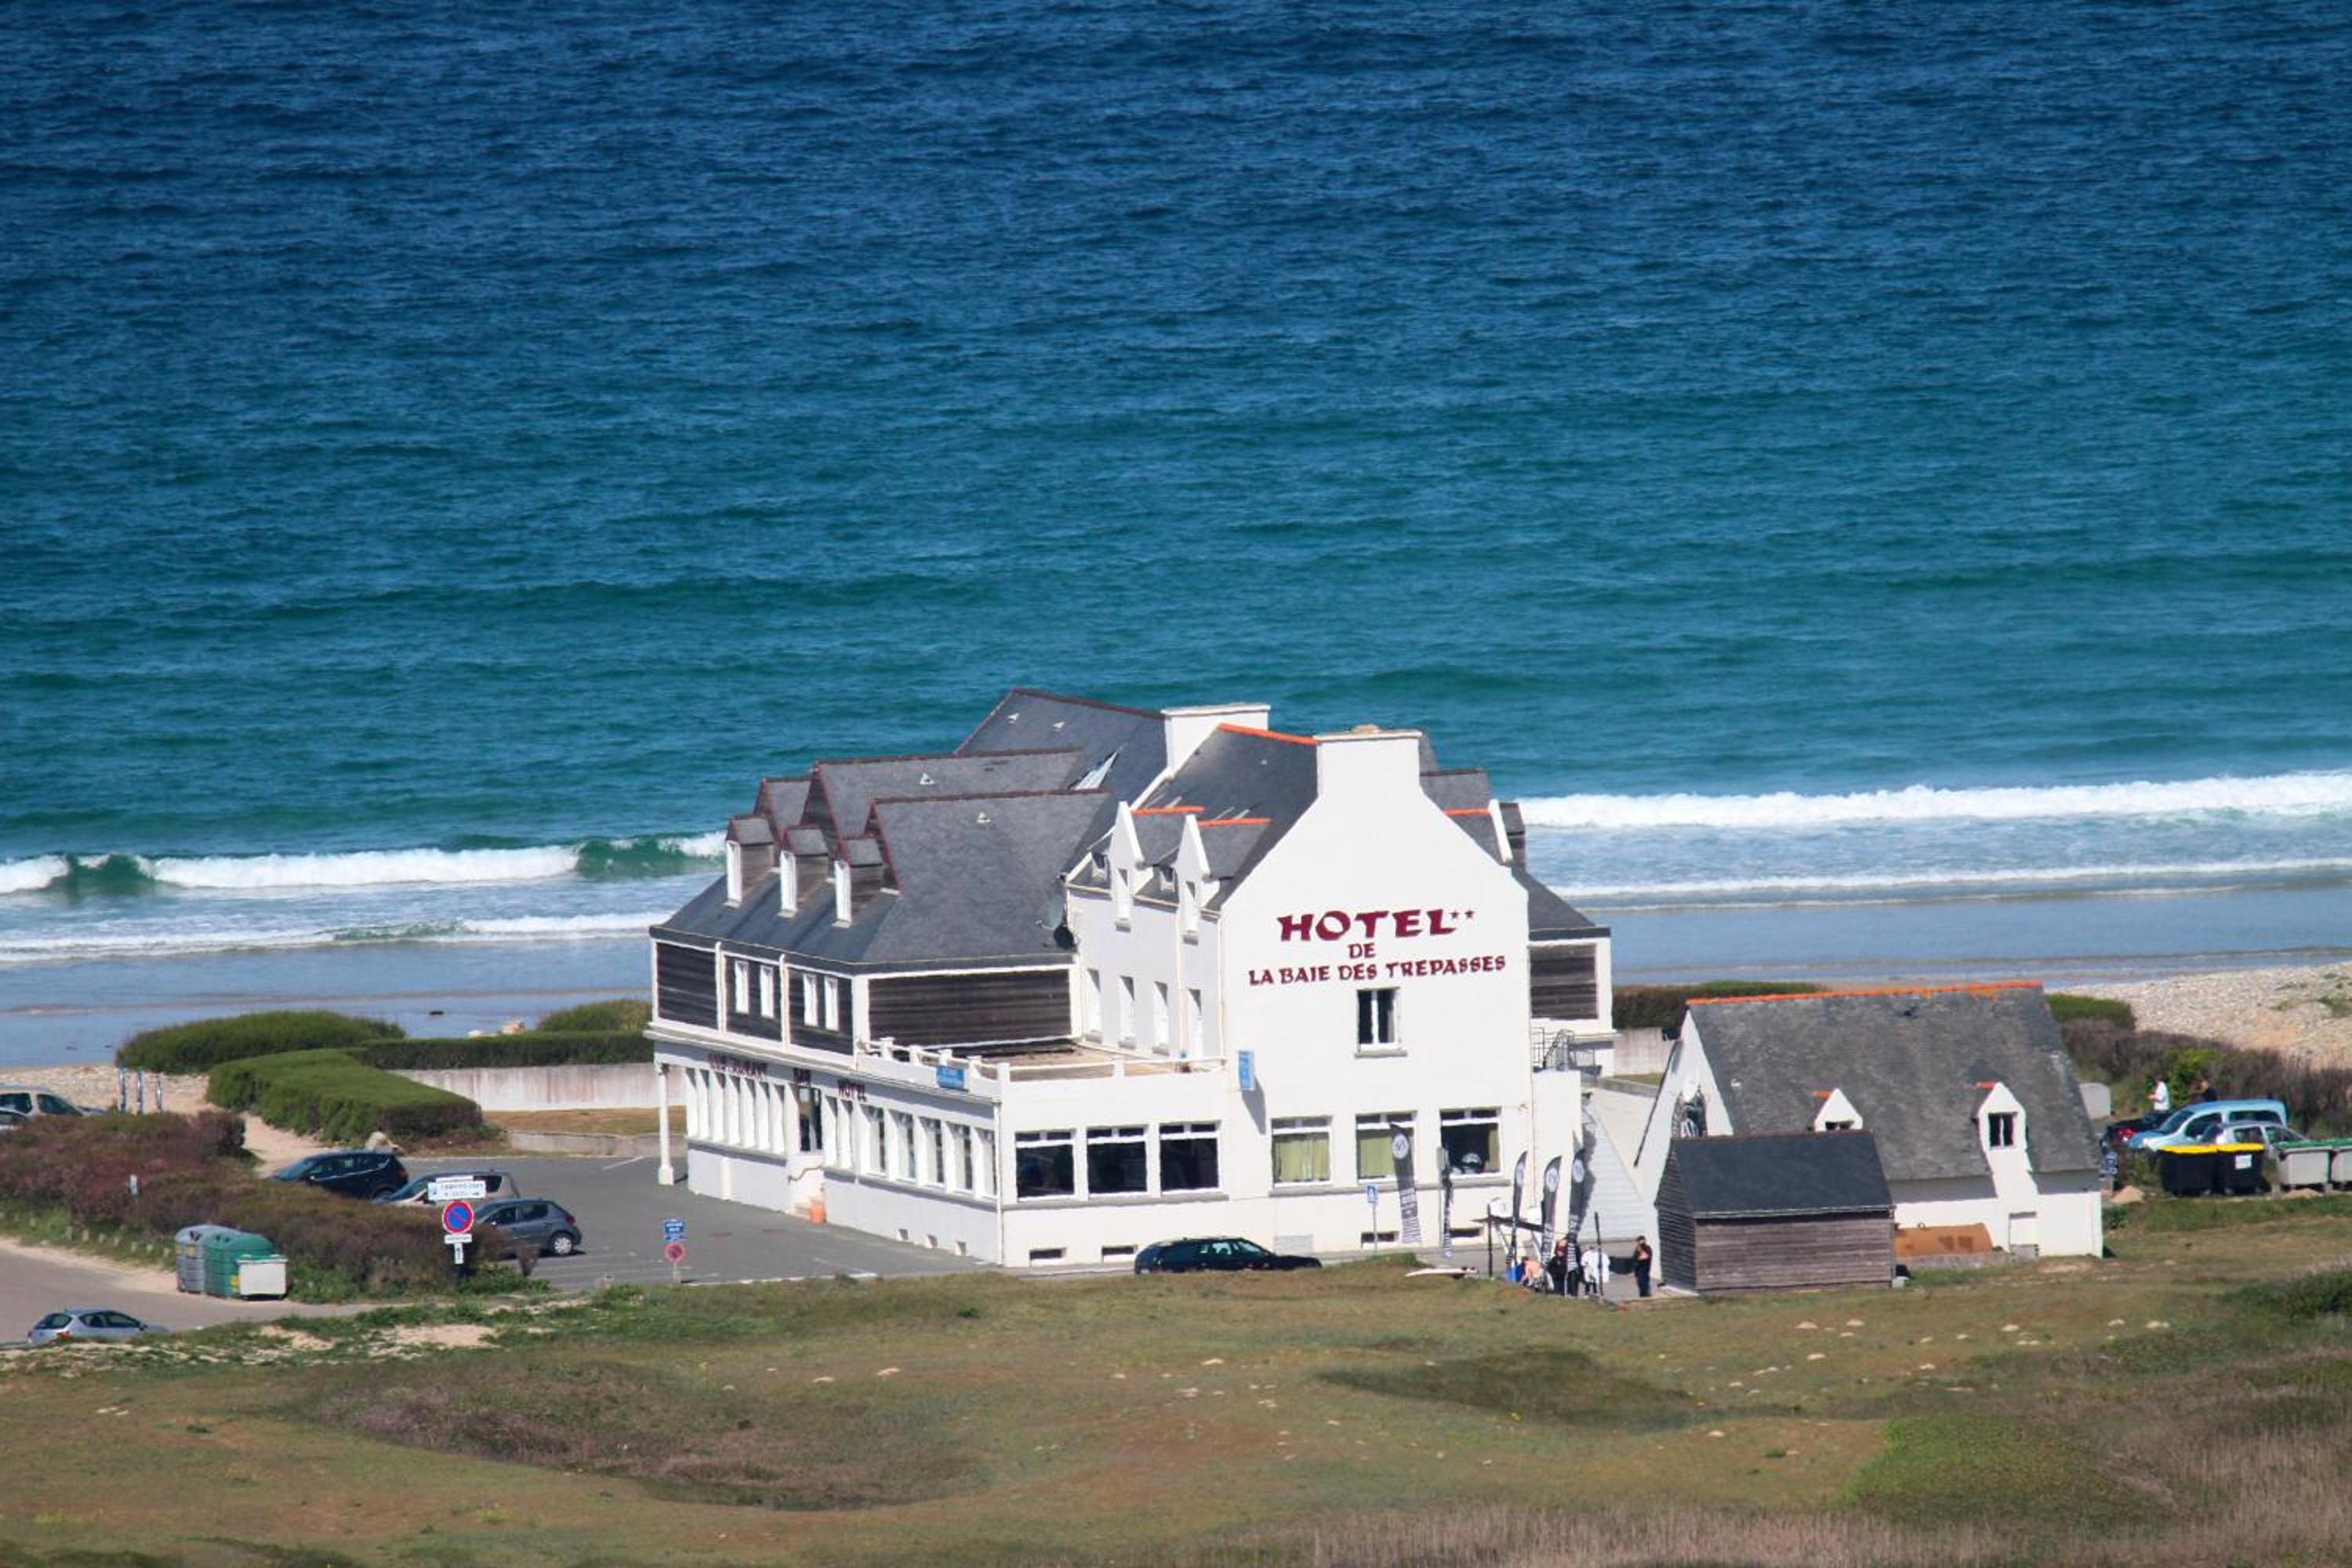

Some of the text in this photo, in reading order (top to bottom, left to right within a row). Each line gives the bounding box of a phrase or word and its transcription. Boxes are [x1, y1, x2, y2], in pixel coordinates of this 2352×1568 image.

[1278, 909, 1456, 942] HOTEL
[1348, 943, 1376, 960] DE
[1249, 955, 1506, 985] LA BAIE DES TREPASSES
